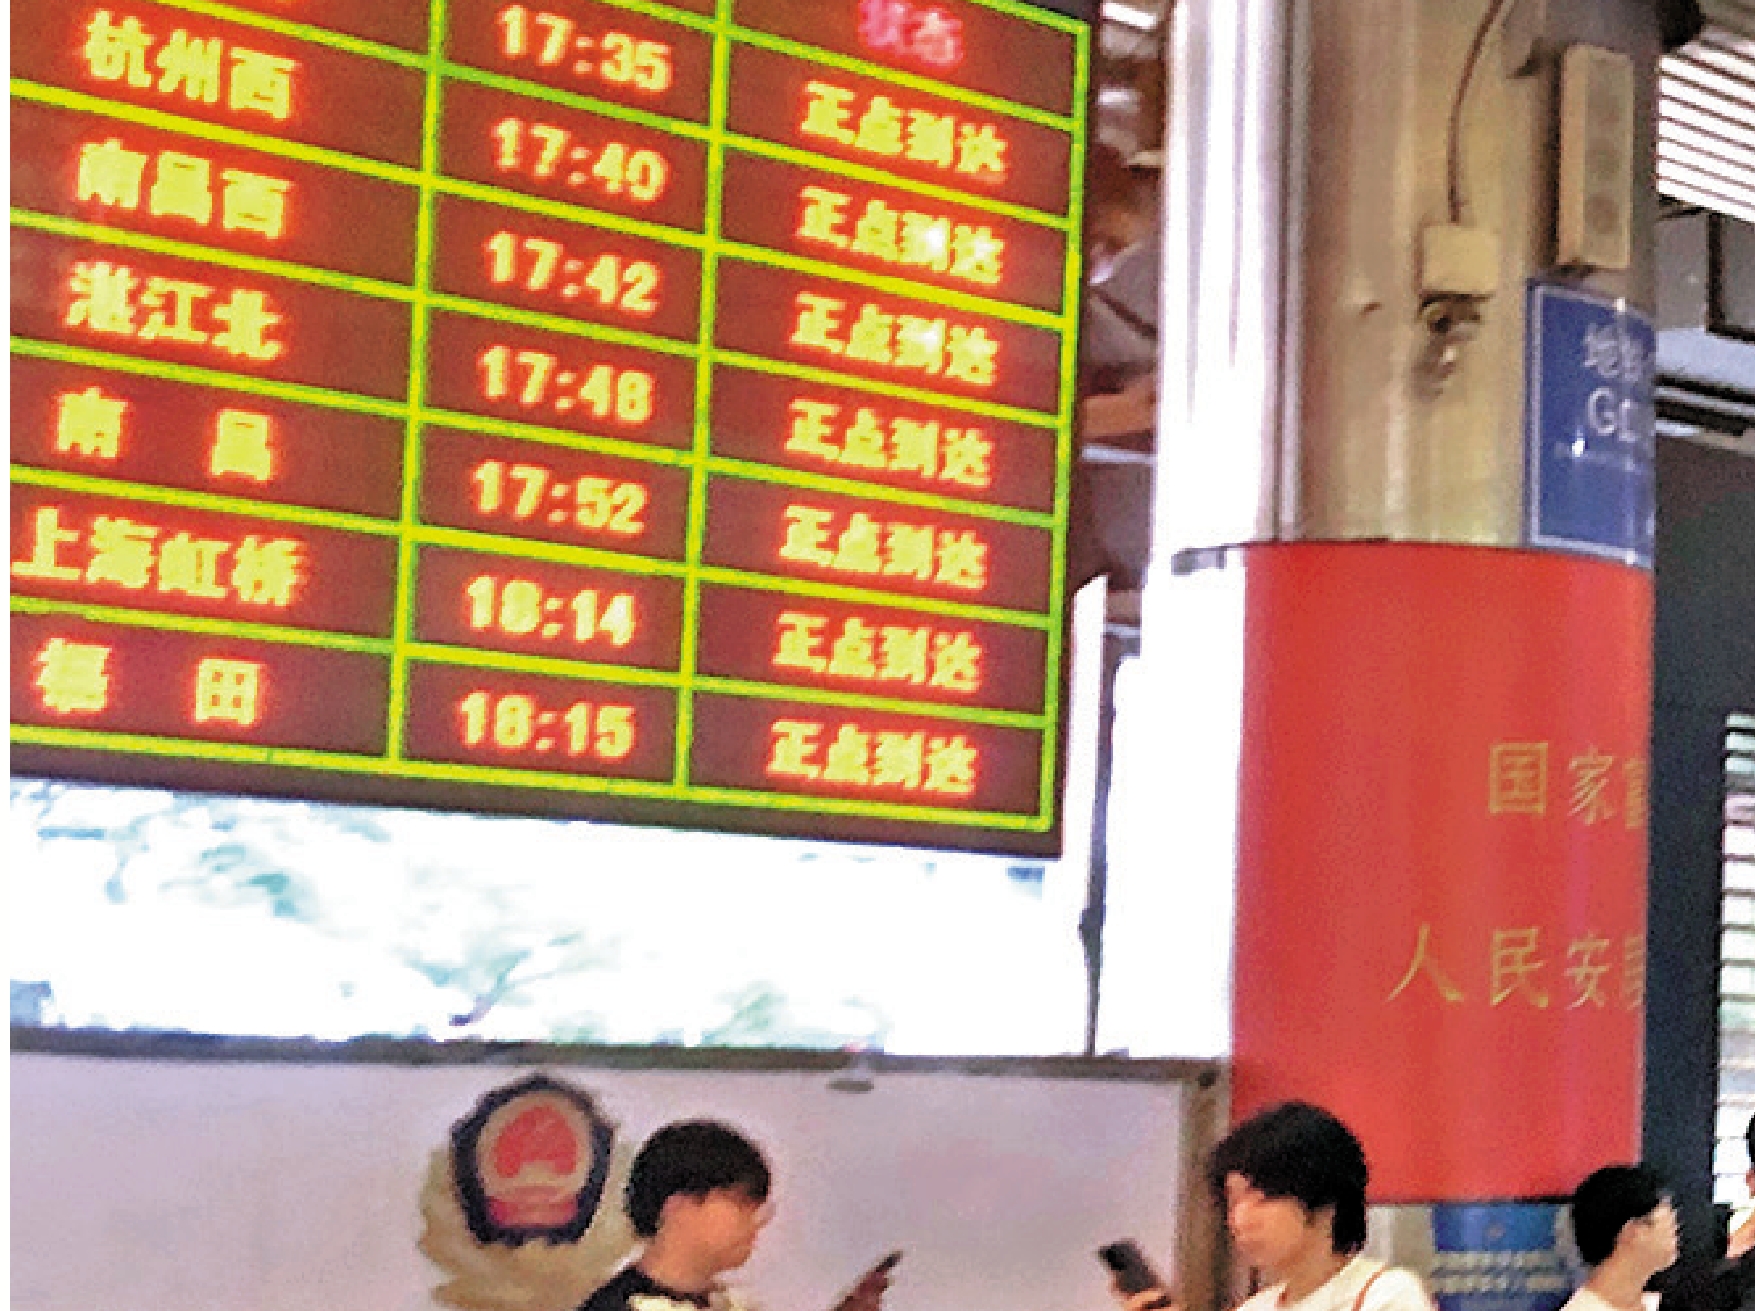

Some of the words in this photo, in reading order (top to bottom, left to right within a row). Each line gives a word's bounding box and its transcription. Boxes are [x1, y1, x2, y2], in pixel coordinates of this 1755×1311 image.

[84, 8, 298, 120] 杭州西
[493, 117, 668, 203] 17:40
[796, 186, 1005, 287] 正点到达
[497, 4, 673, 93] 17:35
[798, 81, 1007, 180] 正点到达
[75, 138, 296, 240] 南昌西
[485, 230, 660, 315] 17:42
[791, 292, 1000, 388] 正点到达
[66, 260, 284, 361] 湛江北
[478, 344, 655, 424] 17:48
[784, 398, 995, 490] 正点到达
[9, 506, 307, 607] 上海虹桥
[772, 611, 983, 694] 正点到达
[472, 461, 648, 536] 17:52
[779, 504, 989, 592] 正点到达
[458, 690, 636, 760] 18:15
[767, 719, 979, 799] 正点到达
